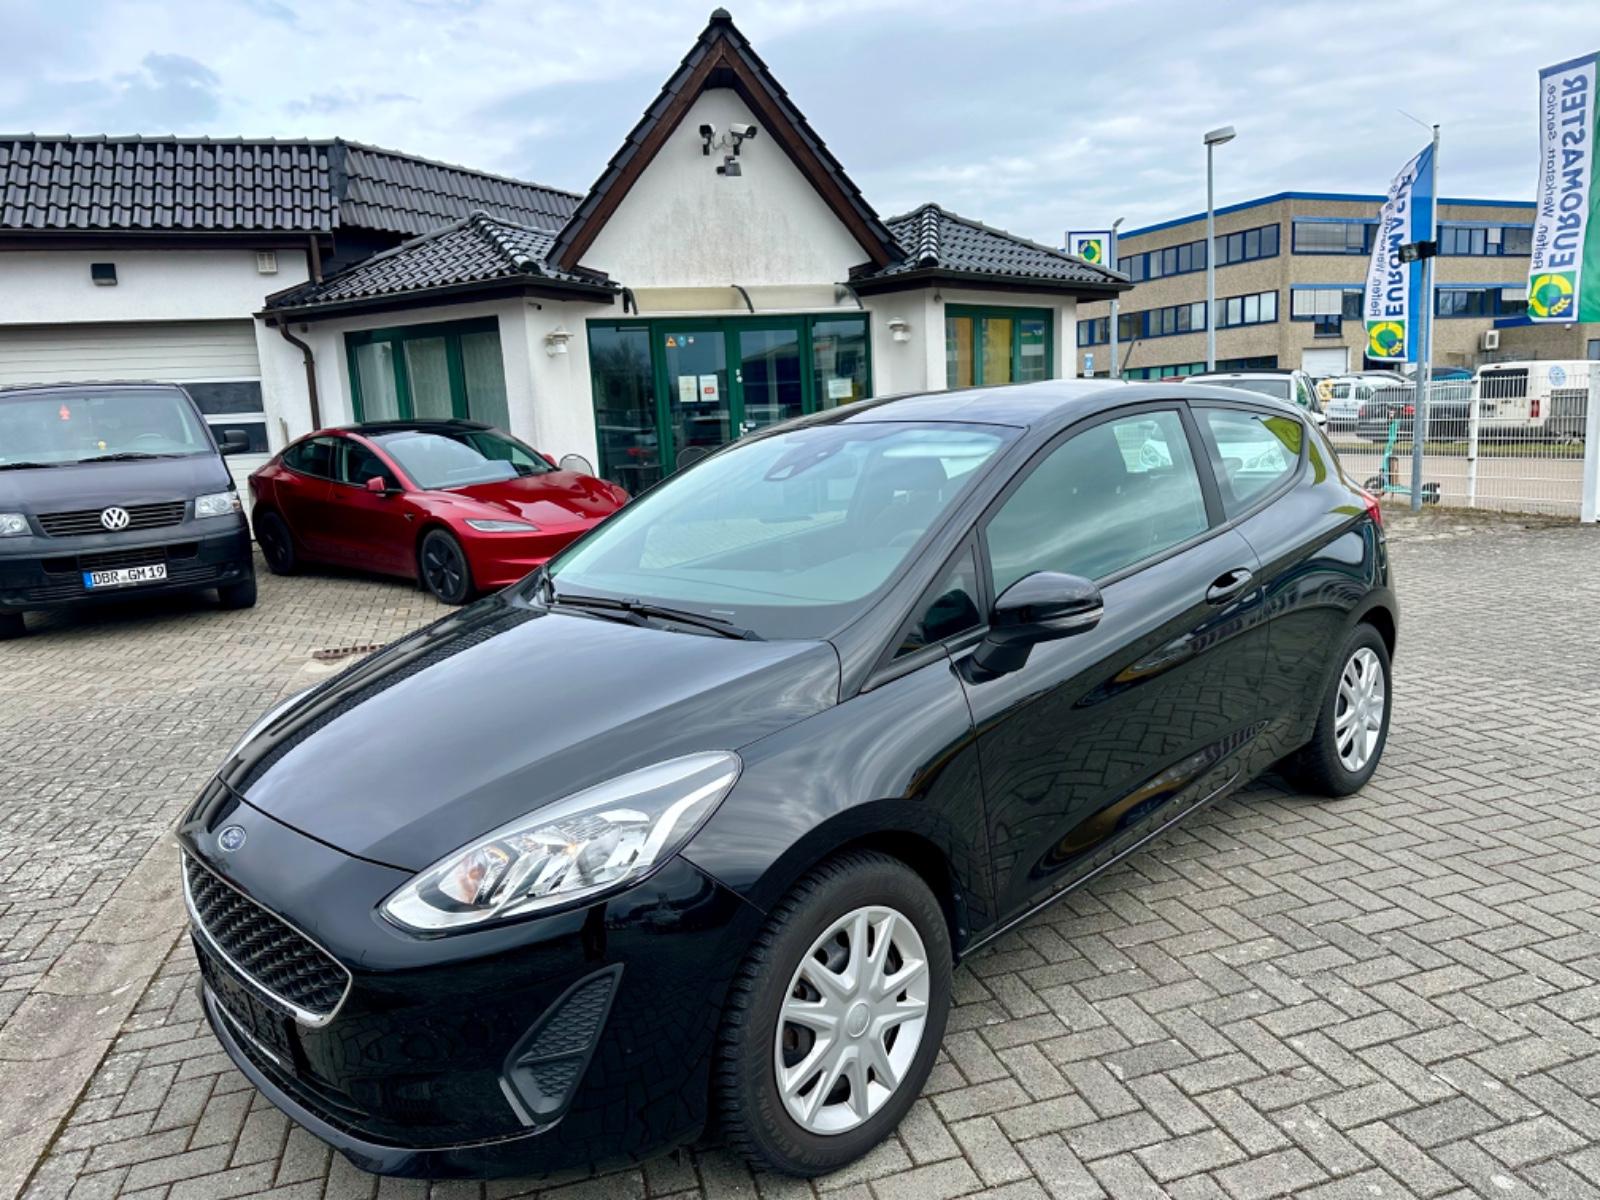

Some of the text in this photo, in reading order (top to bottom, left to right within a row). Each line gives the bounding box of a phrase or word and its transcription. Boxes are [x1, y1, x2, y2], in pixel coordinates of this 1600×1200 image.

[92, 570, 119, 585] DBR
[127, 567, 147, 581] GM
[148, 565, 165, 579] 19
